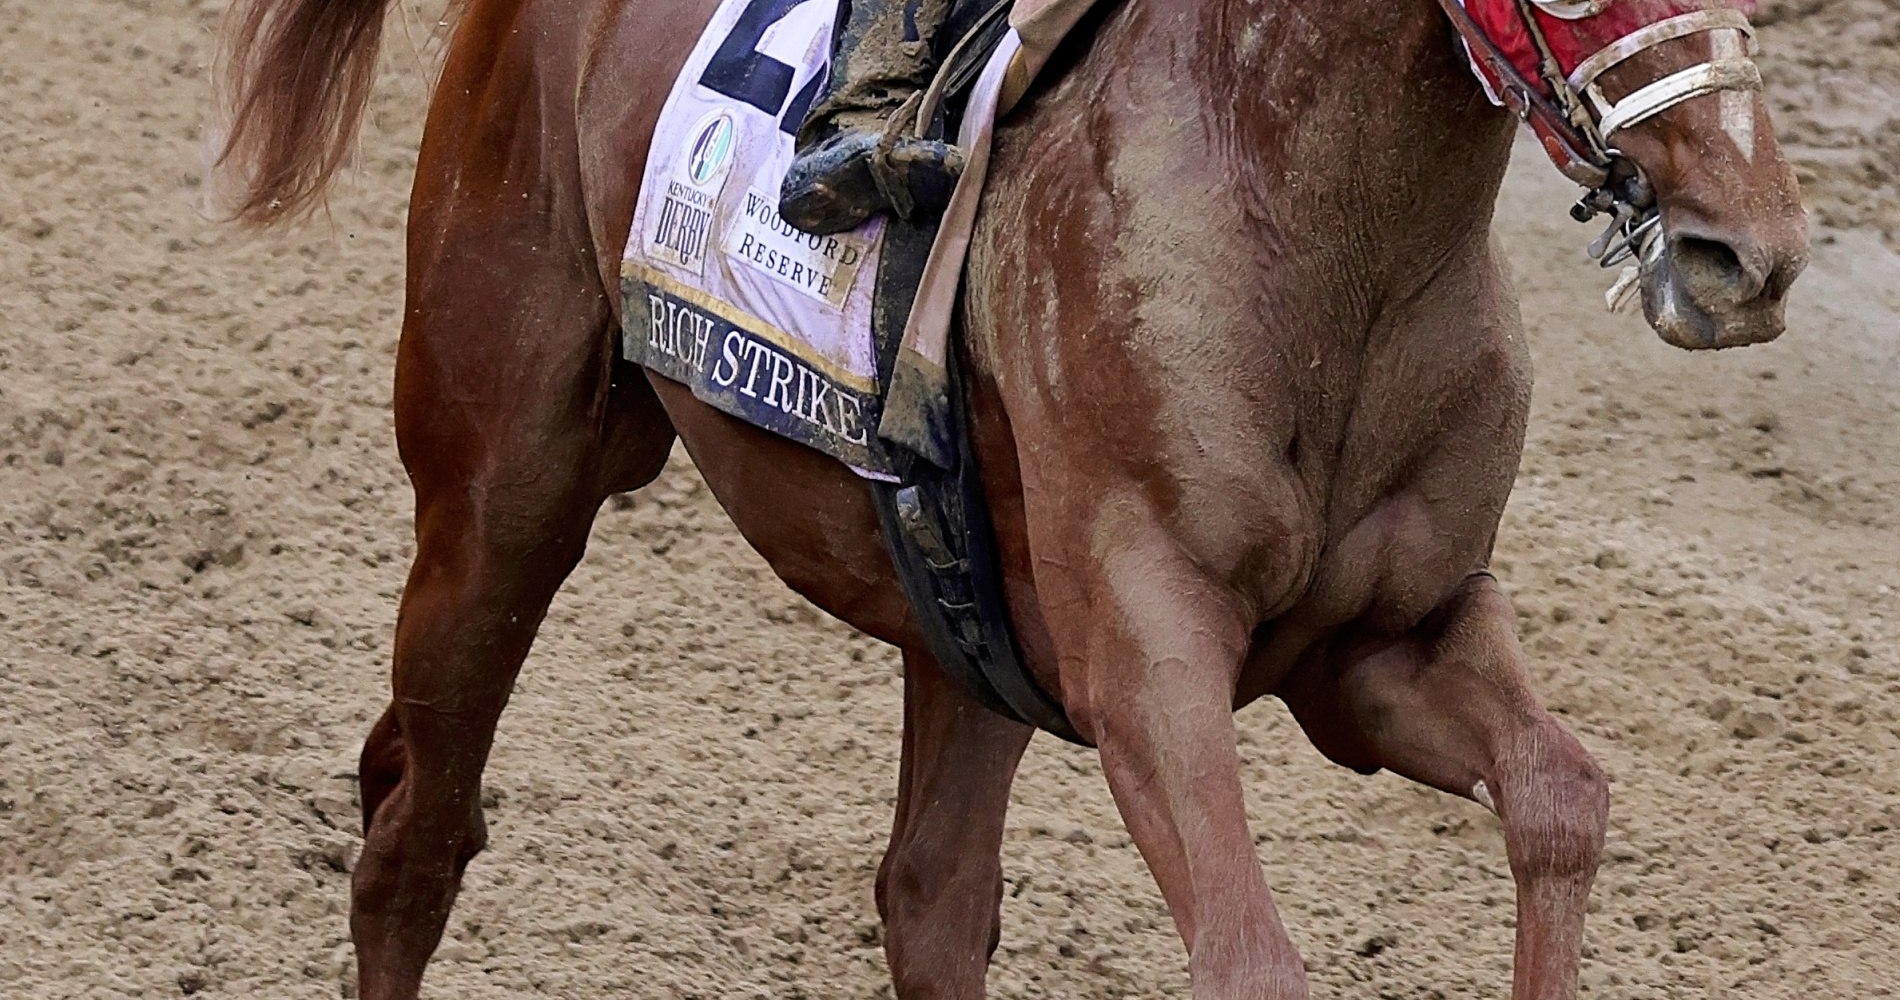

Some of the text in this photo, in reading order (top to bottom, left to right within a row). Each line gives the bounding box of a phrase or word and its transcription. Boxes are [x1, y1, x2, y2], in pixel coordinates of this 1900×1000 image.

[667, 180, 708, 208] KENTUCKY
[654, 196, 711, 266] DERBY
[738, 232, 833, 298] RESERVE
[649, 294, 868, 447] RICH STRIKE
